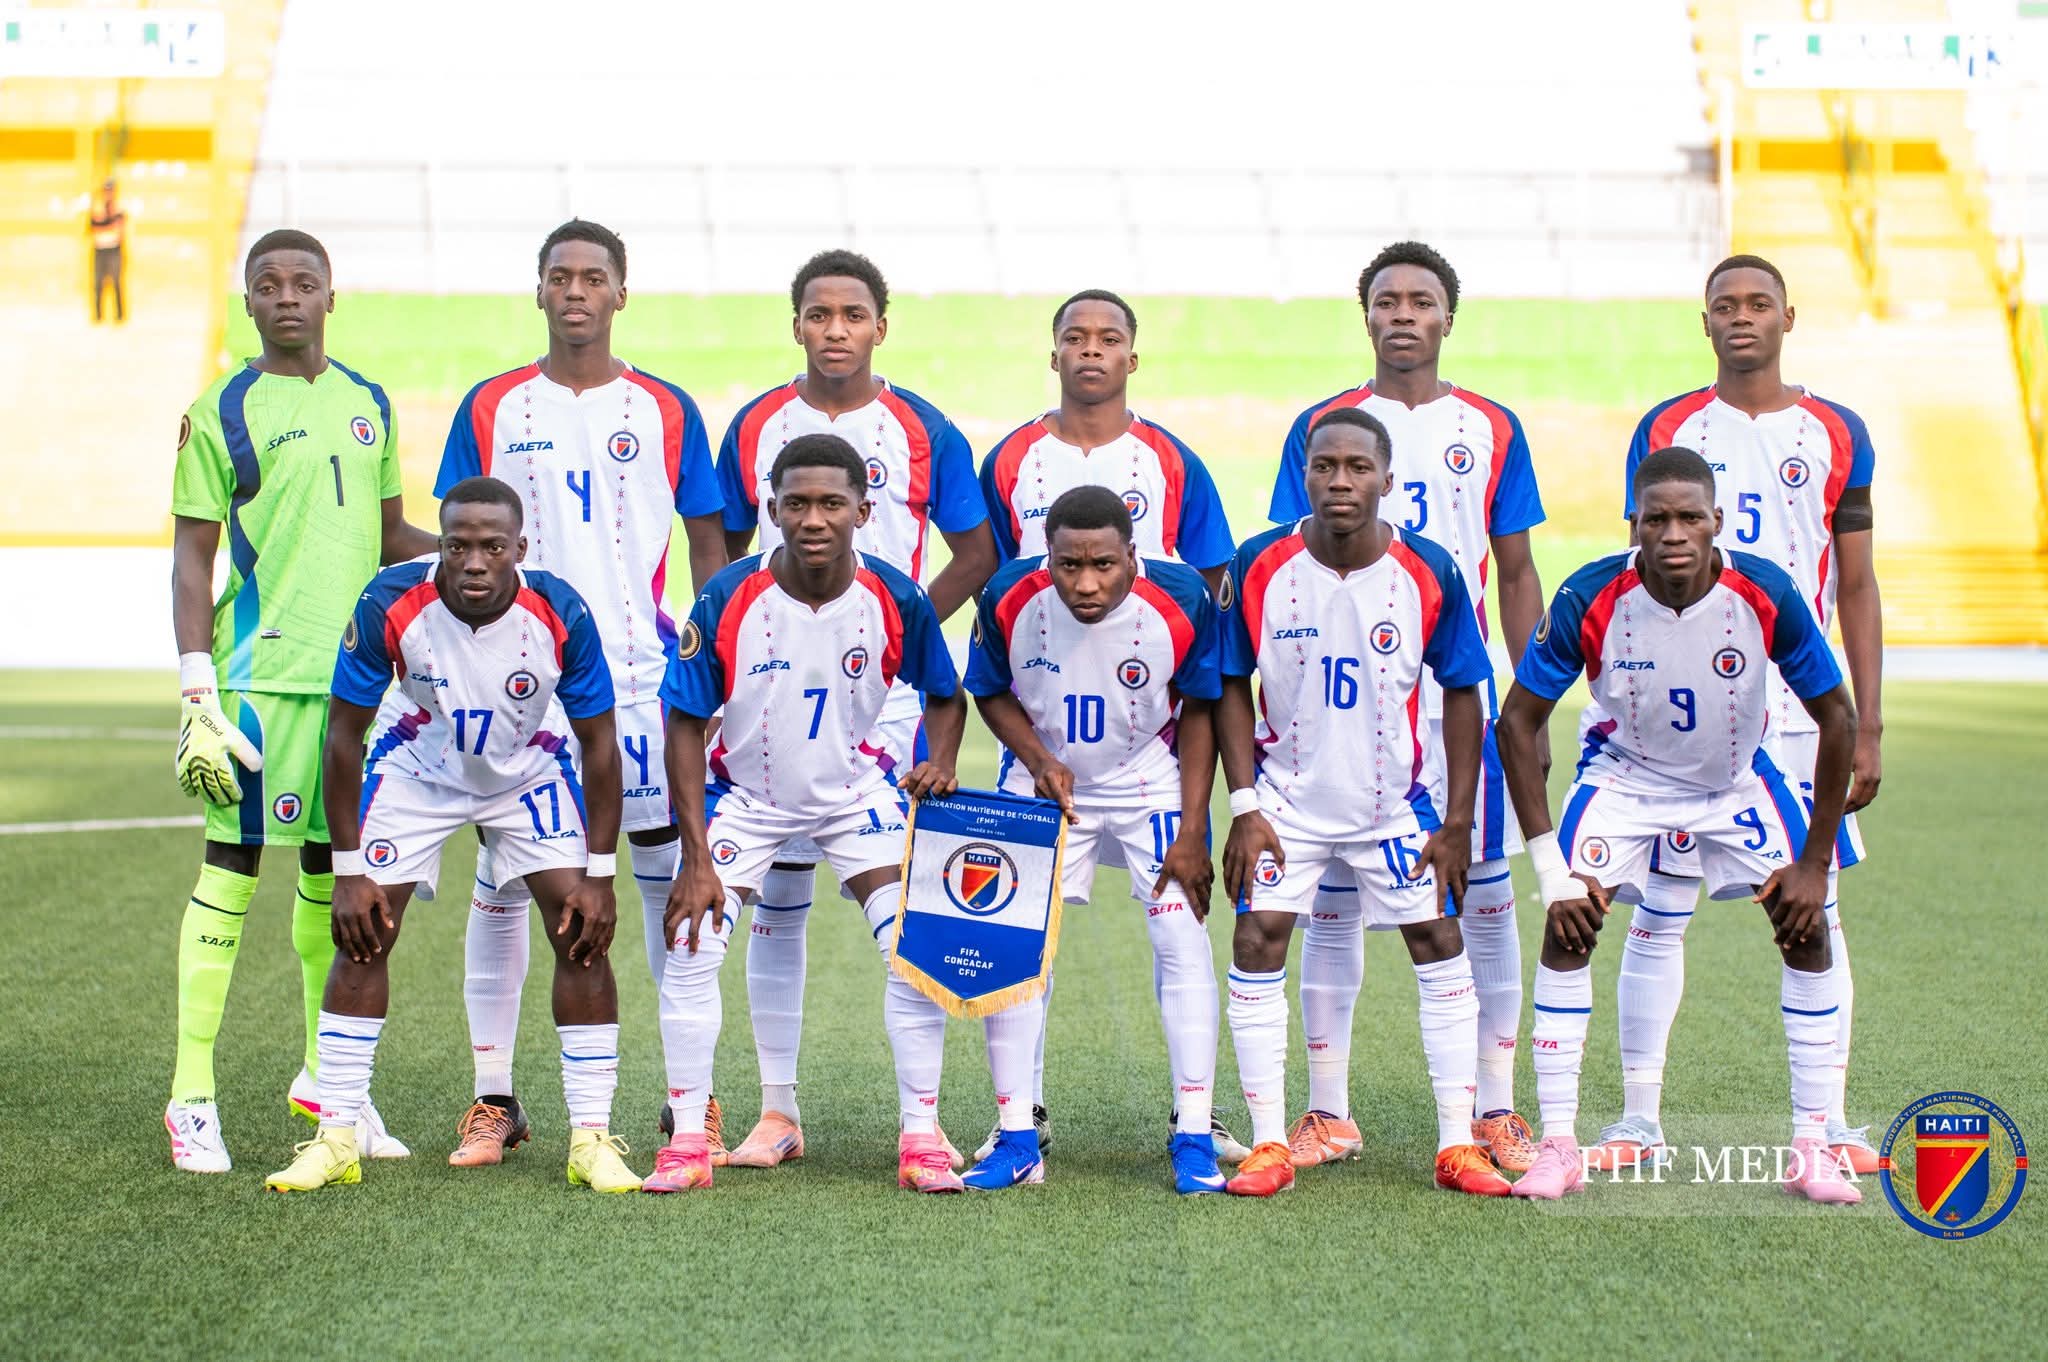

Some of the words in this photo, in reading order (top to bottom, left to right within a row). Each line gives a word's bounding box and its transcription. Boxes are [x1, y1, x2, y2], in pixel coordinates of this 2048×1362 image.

[267, 429, 308, 451] SAETA
[504, 441, 554, 454] SAETA
[330, 455, 344, 506] 1
[567, 470, 590, 522] 4
[1023, 506, 1049, 520] SAE
[1403, 481, 1428, 533] 3
[1736, 492, 1762, 543] 5
[1272, 627, 1319, 640] SAETA
[748, 660, 791, 676] SAETA
[1321, 656, 1359, 709] 16
[1609, 660, 1655, 672] SAETA
[803, 688, 828, 740] 7
[1063, 694, 1105, 743] 10
[1669, 688, 1696, 732] 9
[452, 709, 493, 755] 17
[624, 735, 648, 785] 4
[519, 782, 560, 838] 17
[623, 787, 661, 797] AETA
[1006, 811, 1017, 819] DE
[1733, 807, 1767, 850] 9
[968, 854, 998, 865] HAITI
[1379, 833, 1425, 888] 16
[944, 956, 994, 970] CONCACAF
[958, 967, 977, 978] CFU
[960, 947, 980, 958] FIFA
